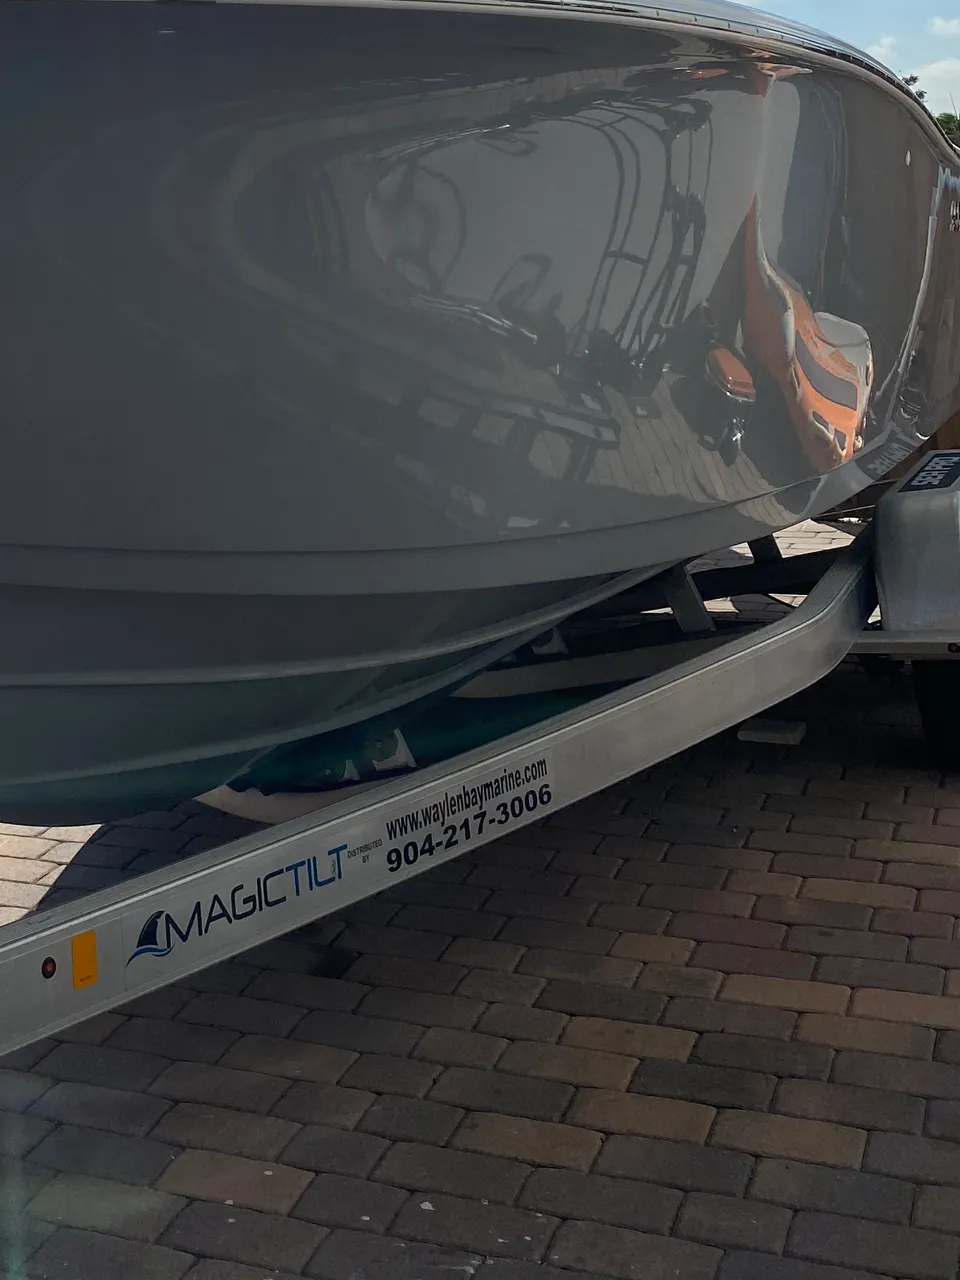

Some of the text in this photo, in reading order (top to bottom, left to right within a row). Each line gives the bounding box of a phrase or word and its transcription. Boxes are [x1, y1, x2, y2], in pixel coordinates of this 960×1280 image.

[386, 758, 548, 841] www.waylenbaymarine.com
[386, 783, 552, 873] 904-217-3006
[347, 838, 383, 859] DISTRIBUTED
[165, 843, 348, 950] MAGICTILT
